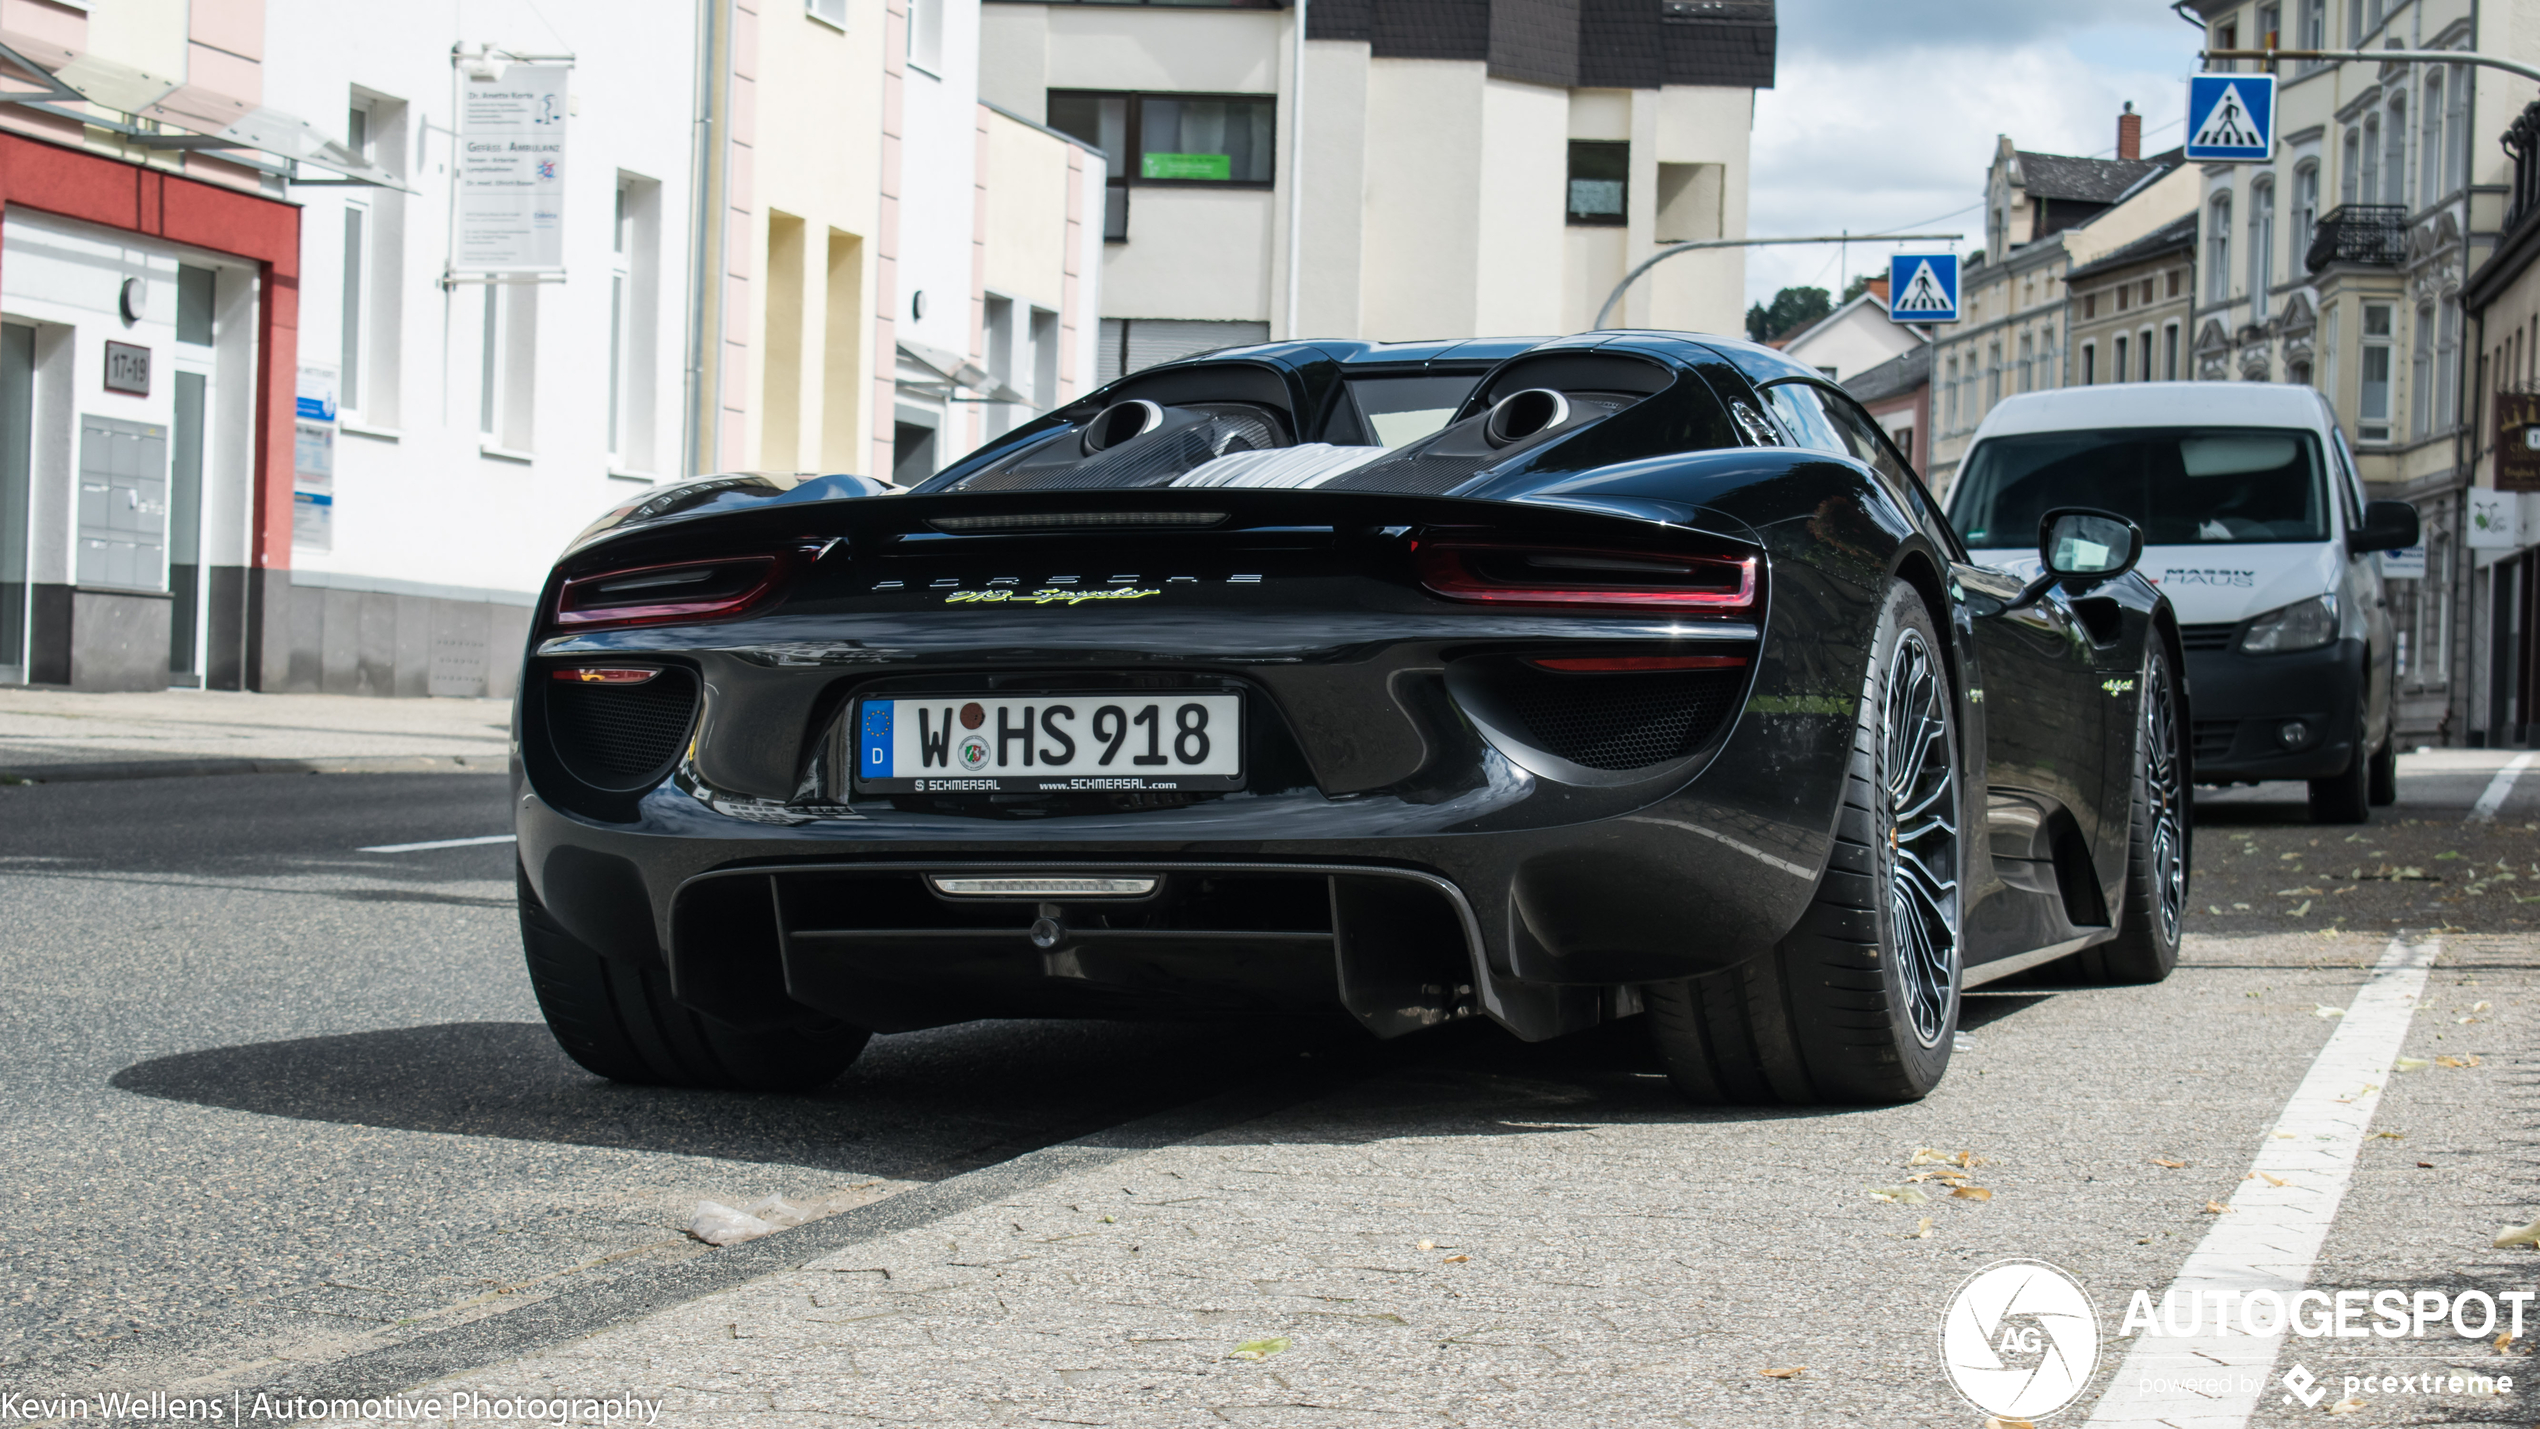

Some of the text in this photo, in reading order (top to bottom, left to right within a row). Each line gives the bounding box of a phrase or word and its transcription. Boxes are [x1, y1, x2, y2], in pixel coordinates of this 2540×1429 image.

[112, 353, 147, 383] 17-19
[2163, 575, 2254, 587] HAUS
[919, 703, 1210, 768] W HS 918
[872, 747, 883, 765] D
[928, 780, 1001, 791] SCHMERSAL
[1039, 778, 1177, 790] www.SCHMERSAL.com
